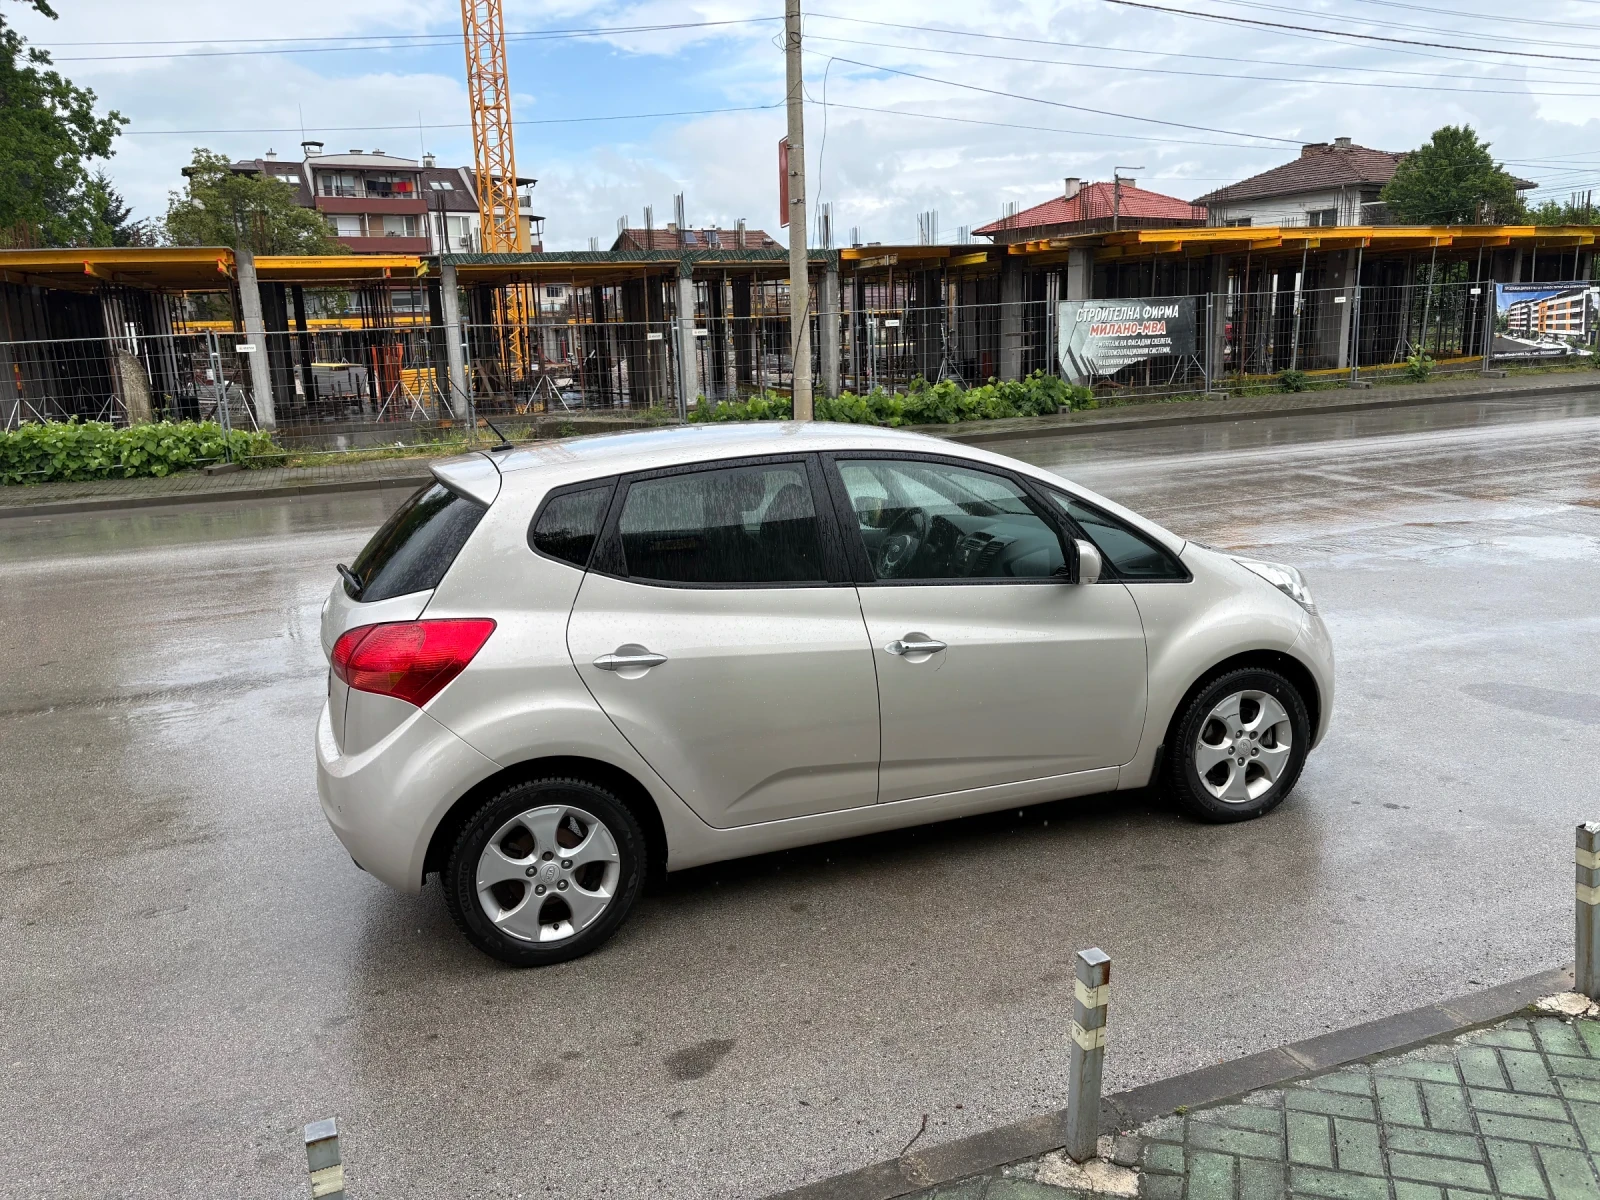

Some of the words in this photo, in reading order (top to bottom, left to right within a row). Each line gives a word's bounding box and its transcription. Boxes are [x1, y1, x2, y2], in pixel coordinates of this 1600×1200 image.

[1076, 307, 1140, 322] СТРОИТЕЛНА
[1142, 304, 1179, 319] ФИРМА
[1089, 321, 1167, 337] МИЛАНО-МВА
[459, 861, 472, 913] KUMHO
